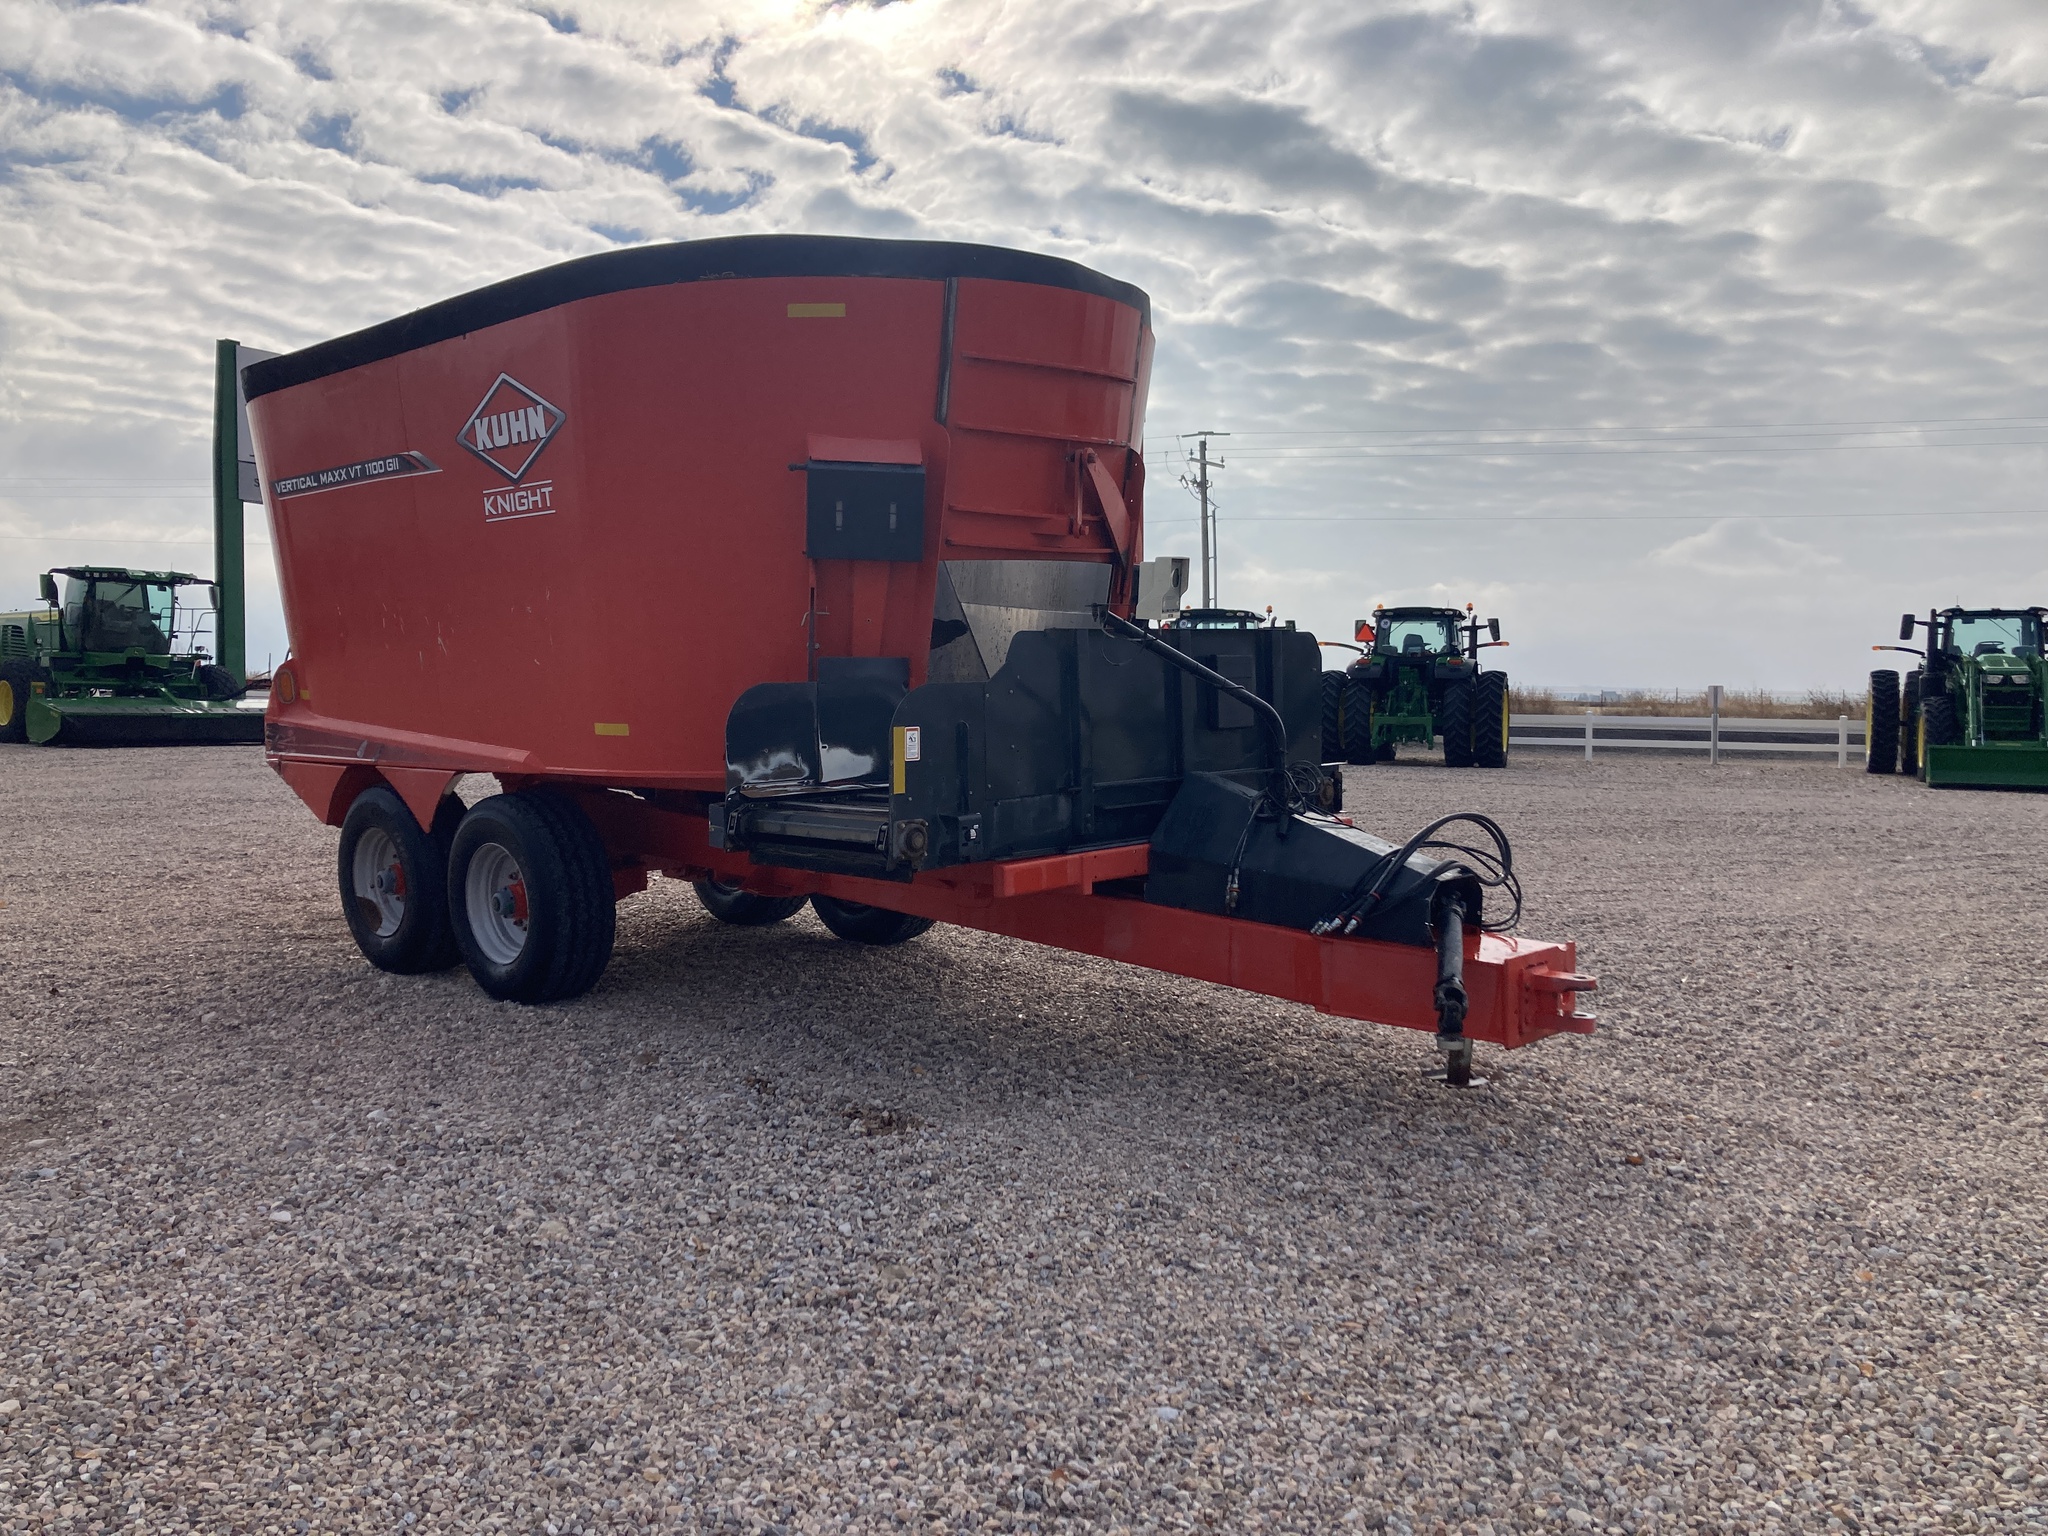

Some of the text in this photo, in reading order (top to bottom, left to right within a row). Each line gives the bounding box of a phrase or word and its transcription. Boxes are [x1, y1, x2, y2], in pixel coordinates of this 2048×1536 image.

[474, 404, 547, 451] KUHN
[275, 475, 318, 494] VERTICAL
[319, 468, 348, 485] MAXX
[348, 465, 362, 479] VT
[364, 460, 385, 476] 1100
[483, 486, 553, 516] KNIGHT
